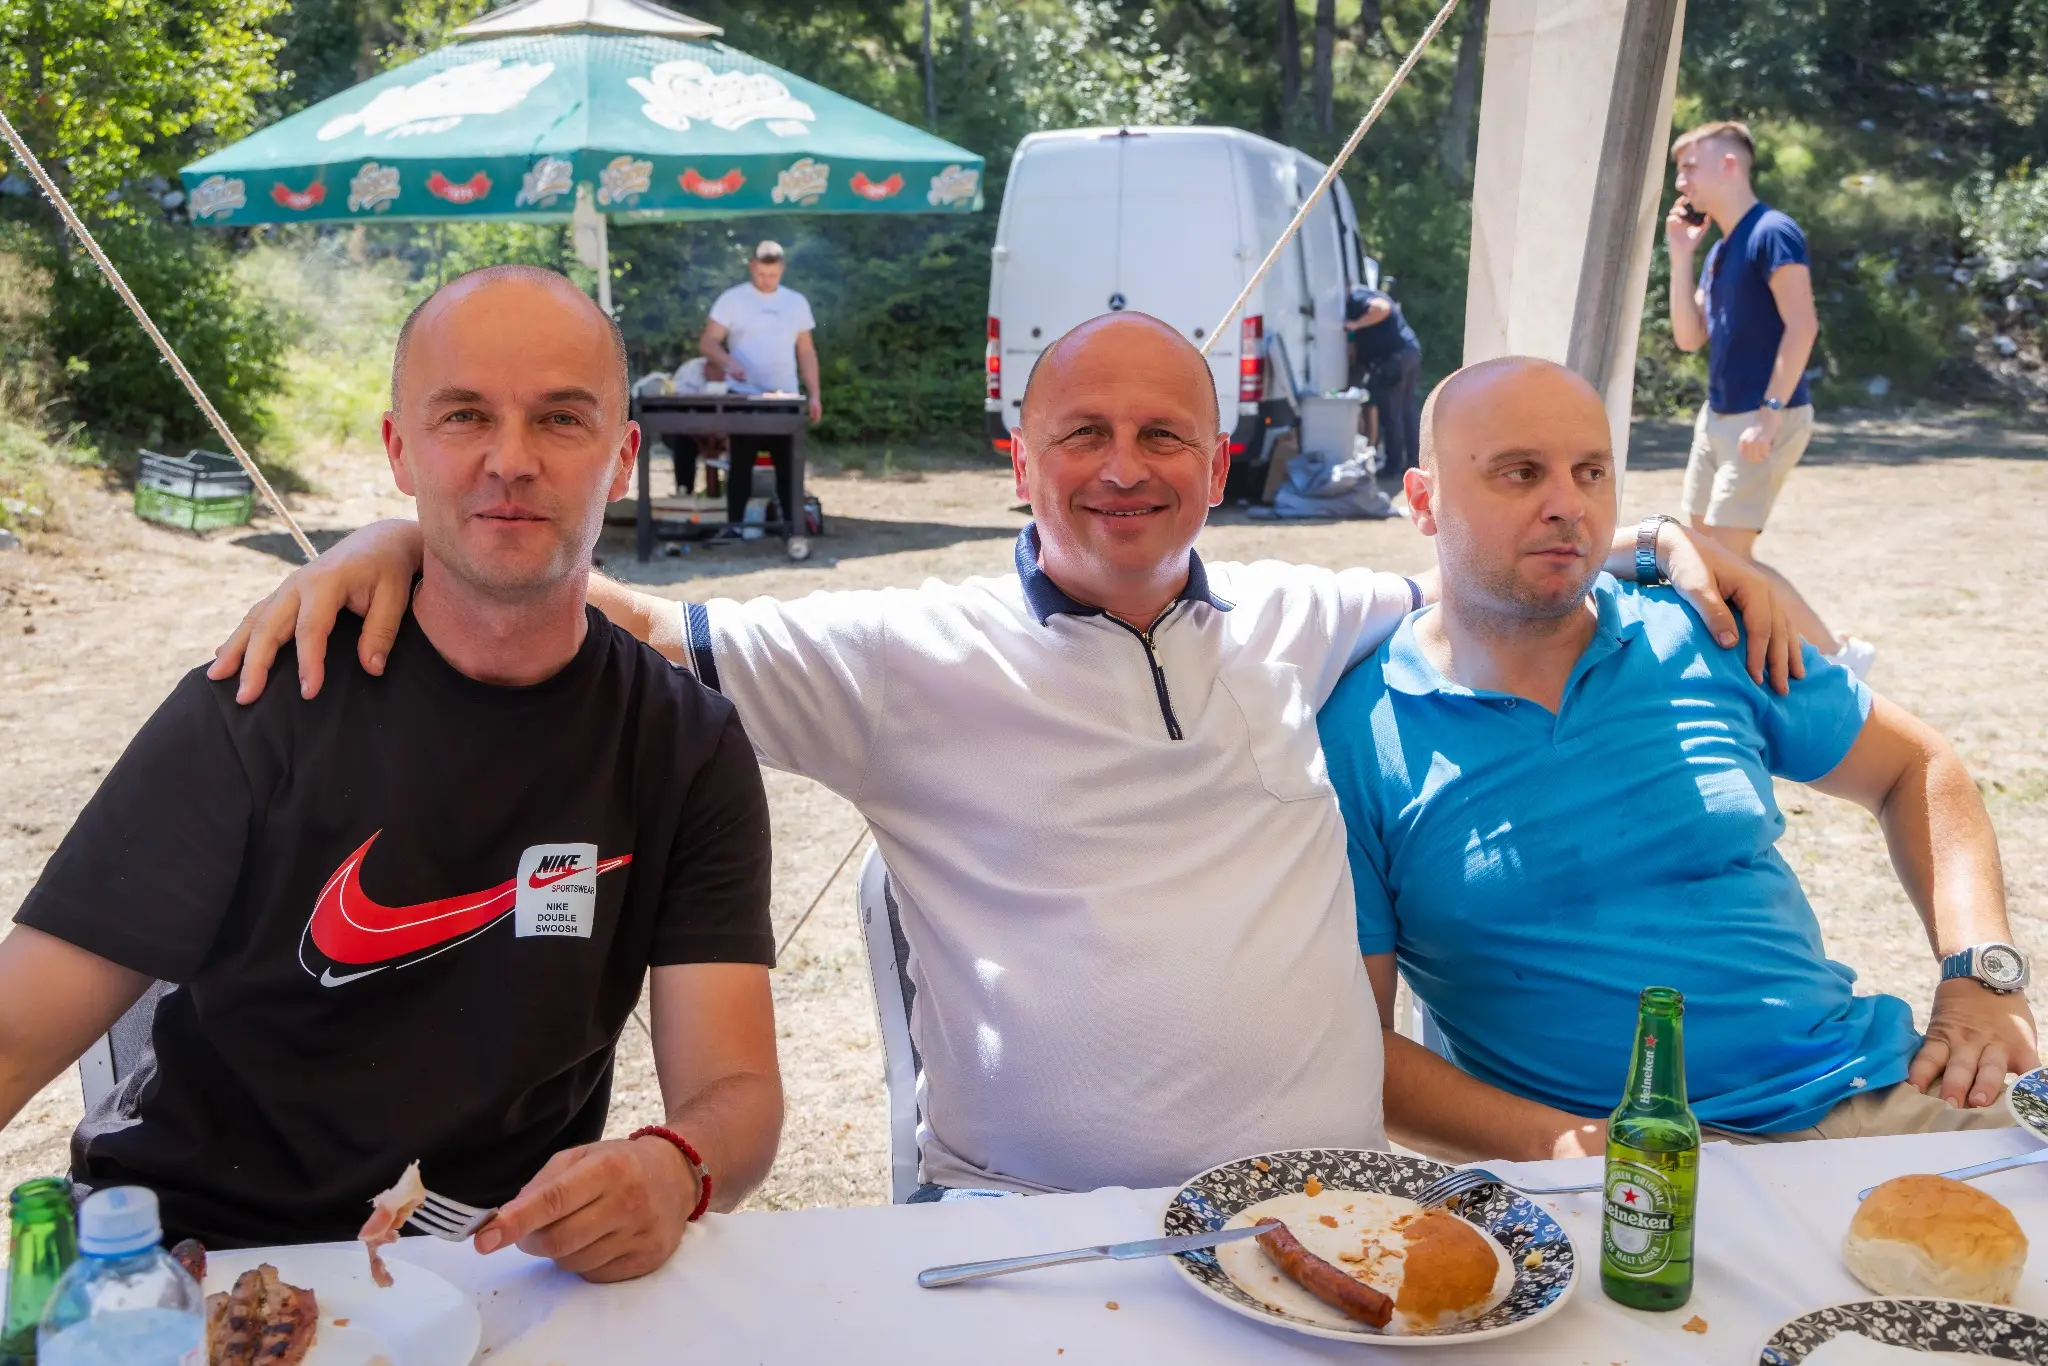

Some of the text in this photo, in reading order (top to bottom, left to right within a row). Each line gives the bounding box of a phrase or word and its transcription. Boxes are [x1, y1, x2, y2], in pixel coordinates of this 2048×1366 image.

[537, 854, 581, 873] NIKE
[551, 884, 595, 895] SPORTSWEAR
[546, 903, 569, 911] NIKE
[537, 913, 577, 922] DOUBLE
[535, 925, 578, 933] SWOOSH
[1640, 1050, 1654, 1104] Heineken
[1634, 1175, 1665, 1206] ORIGINAL
[1616, 1250, 1635, 1264] MALT
[1638, 1246, 1661, 1264] LAGER
